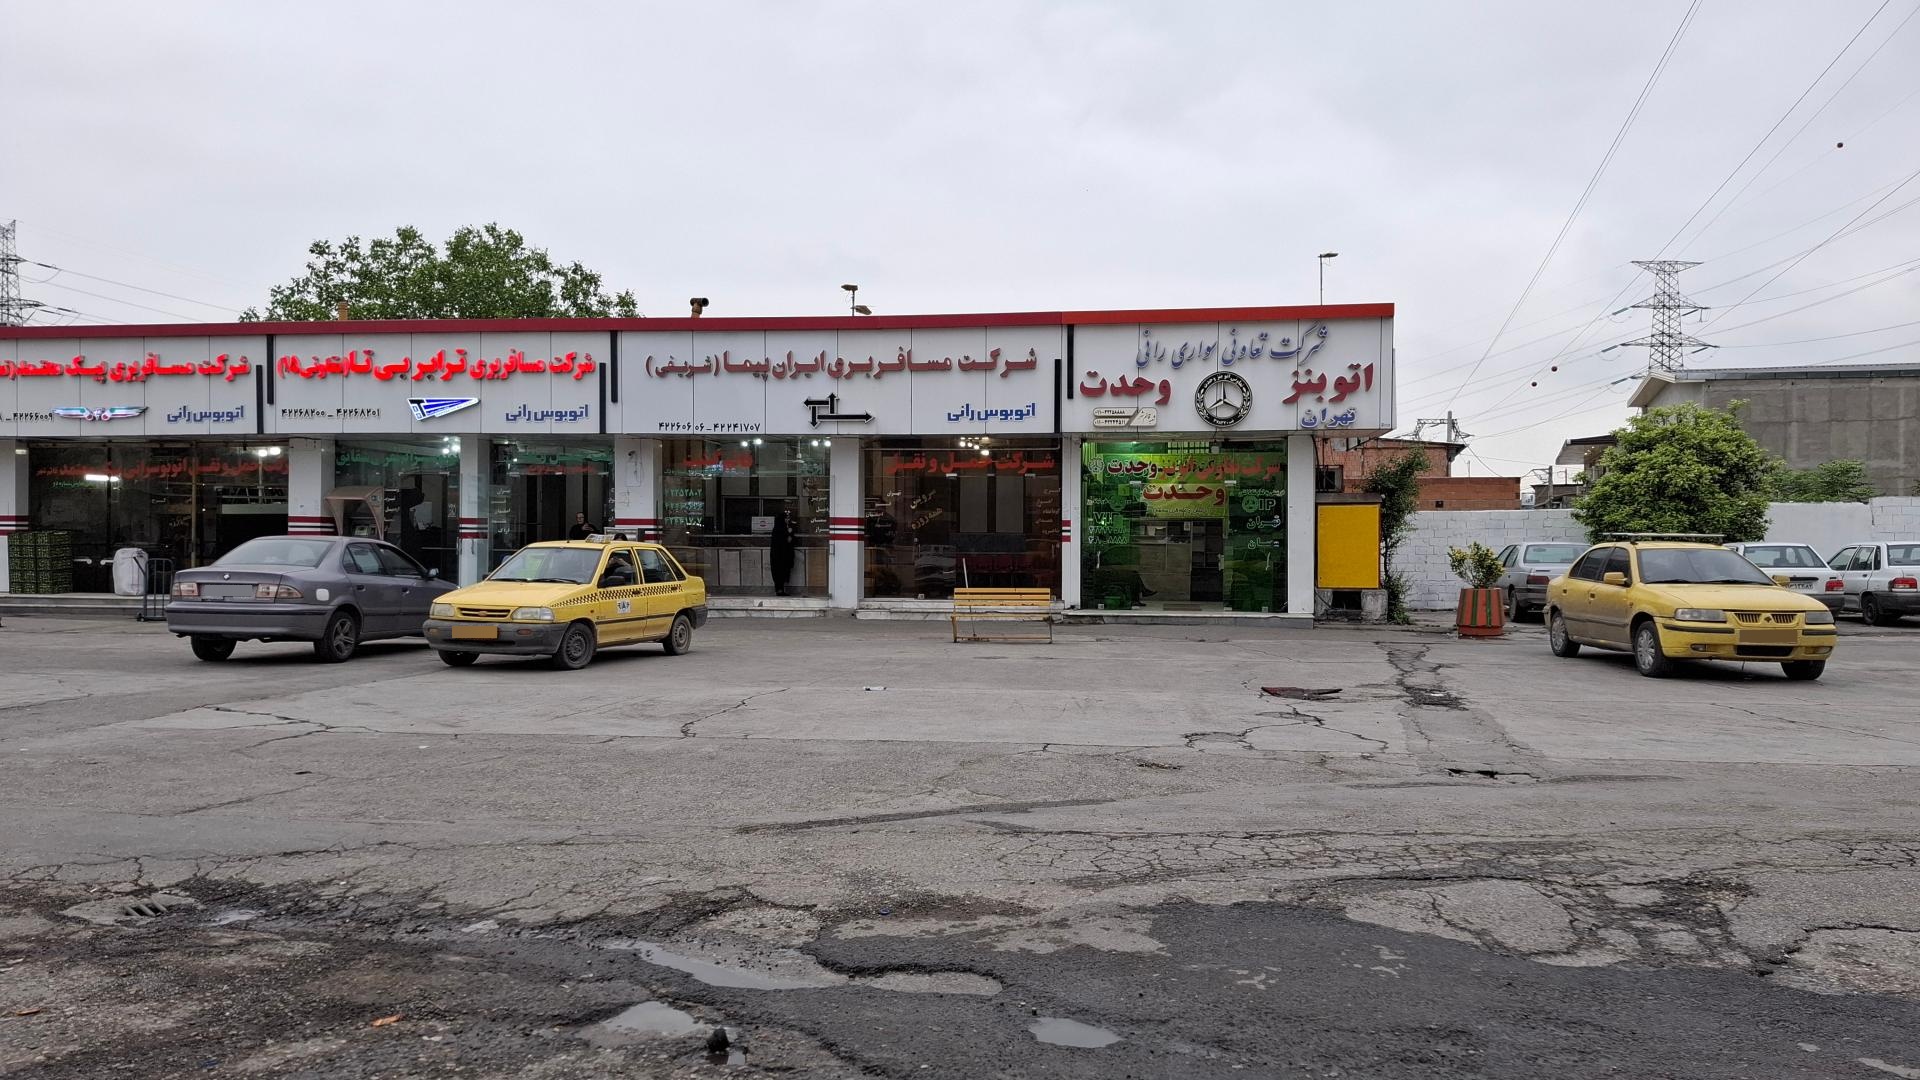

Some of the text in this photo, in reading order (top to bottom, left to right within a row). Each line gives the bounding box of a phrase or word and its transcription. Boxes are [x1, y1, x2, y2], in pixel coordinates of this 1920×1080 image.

[1136, 320, 1328, 369] شرکت تعاونی سواری رانی
[65, 355, 107, 385] پیک
[197, 353, 252, 382] شرکت
[548, 351, 596, 381] شرکت
[645, 346, 1038, 382] شرکت مسافربری ایران پیما (شریفی)
[1079, 370, 1172, 405] وحدت
[167, 405, 244, 423] اتوبوس رانی
[505, 404, 589, 423] اتوبوس رانی
[947, 402, 1036, 421] اتوبوس رانی
[1301, 407, 1357, 428] تهران
[927, 457, 938, 473] و
[941, 453, 992, 473] حمل
[995, 452, 1056, 475] شرکت
[1106, 458, 1158, 479] وحدت
[1142, 484, 1225, 507] وحدت
